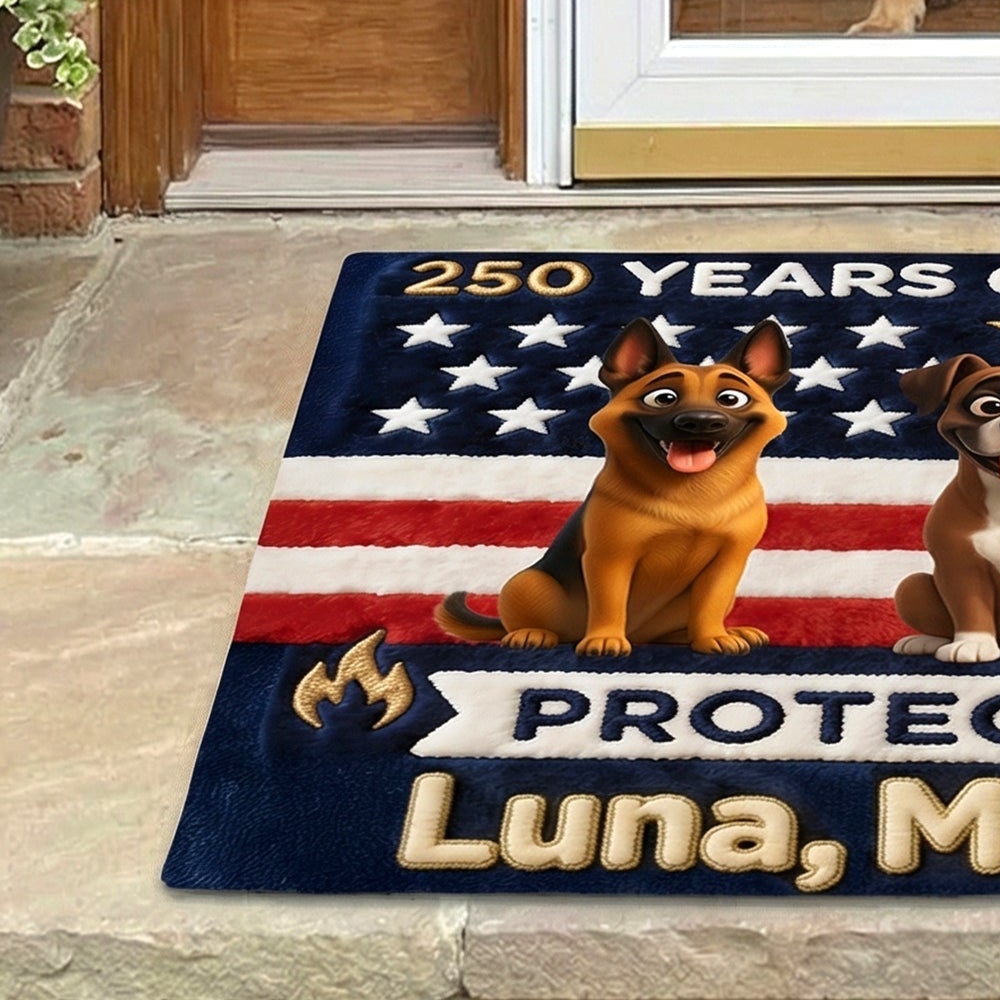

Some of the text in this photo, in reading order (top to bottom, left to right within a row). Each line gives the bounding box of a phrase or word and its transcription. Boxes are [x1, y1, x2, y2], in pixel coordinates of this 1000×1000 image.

[404, 260, 592, 297] 250
[622, 261, 957, 298] YEARS
[397, 771, 848, 893] Luna,
